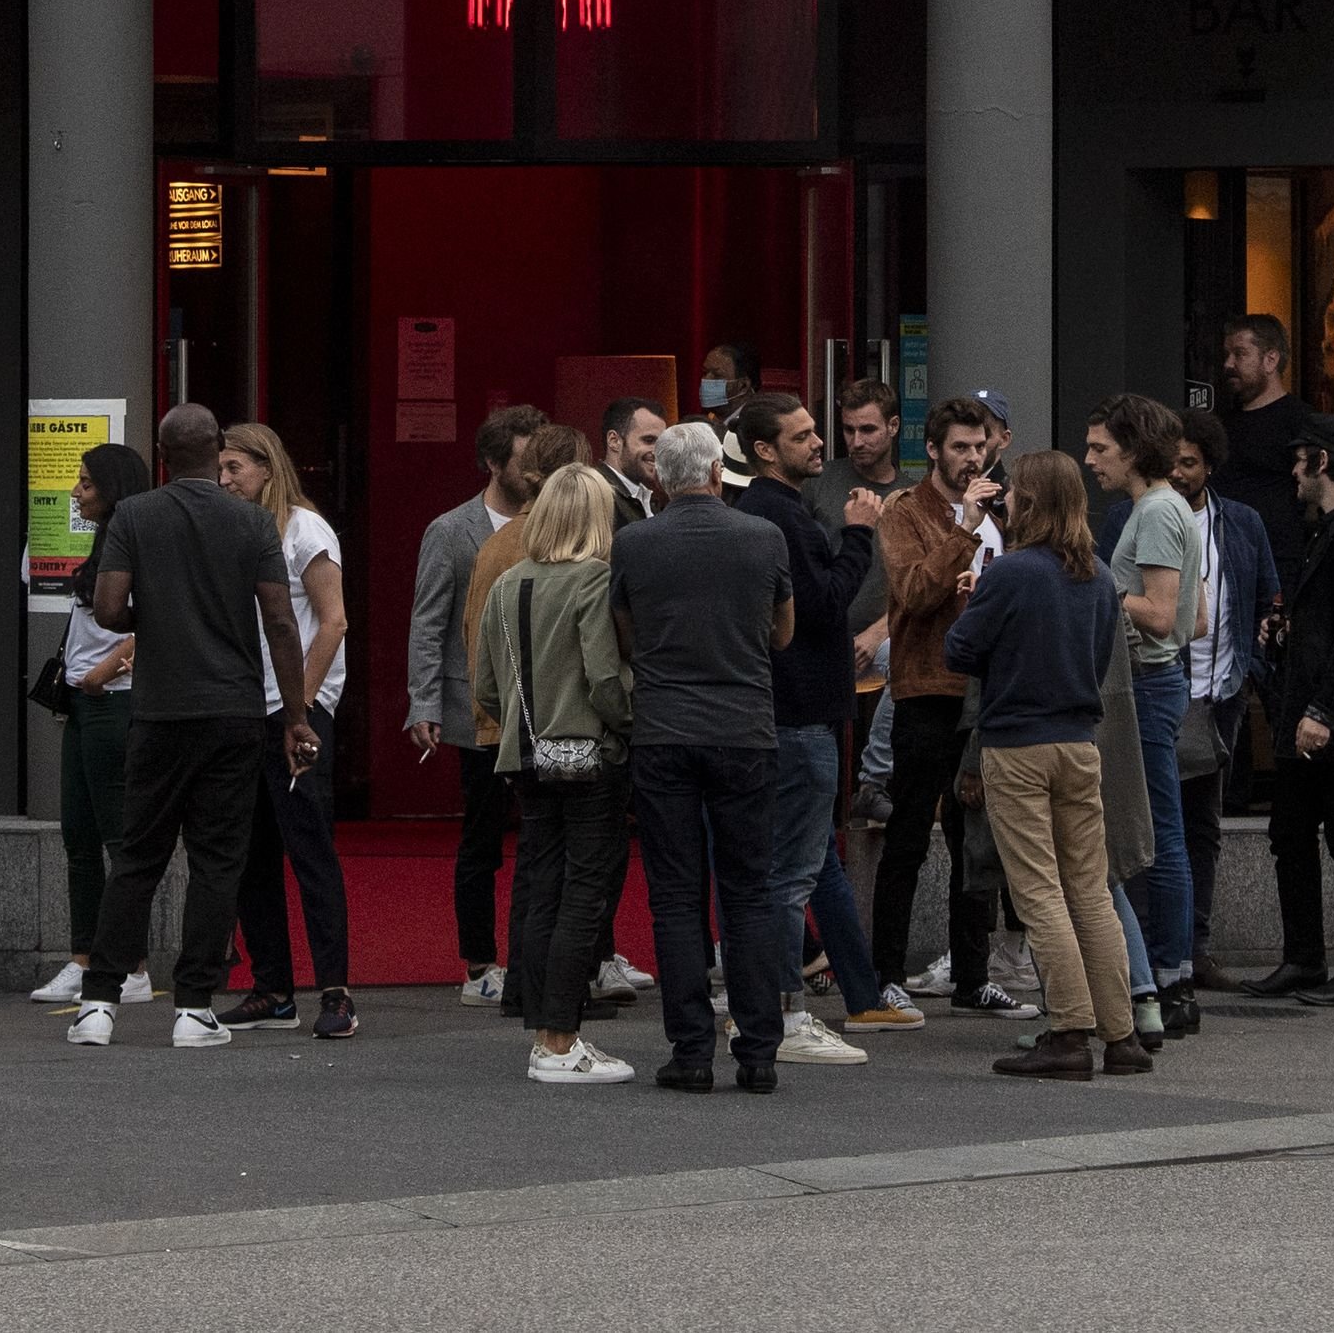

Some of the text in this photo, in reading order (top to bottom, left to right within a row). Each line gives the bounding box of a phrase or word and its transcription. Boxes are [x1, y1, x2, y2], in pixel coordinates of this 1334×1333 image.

[178, 220, 189, 230] VOR
[1189, 388, 1208, 407] BAR
[49, 420, 88, 433] GÄSTE
[33, 496, 58, 506] ENTRY
[39, 562, 67, 571] ENTRY
